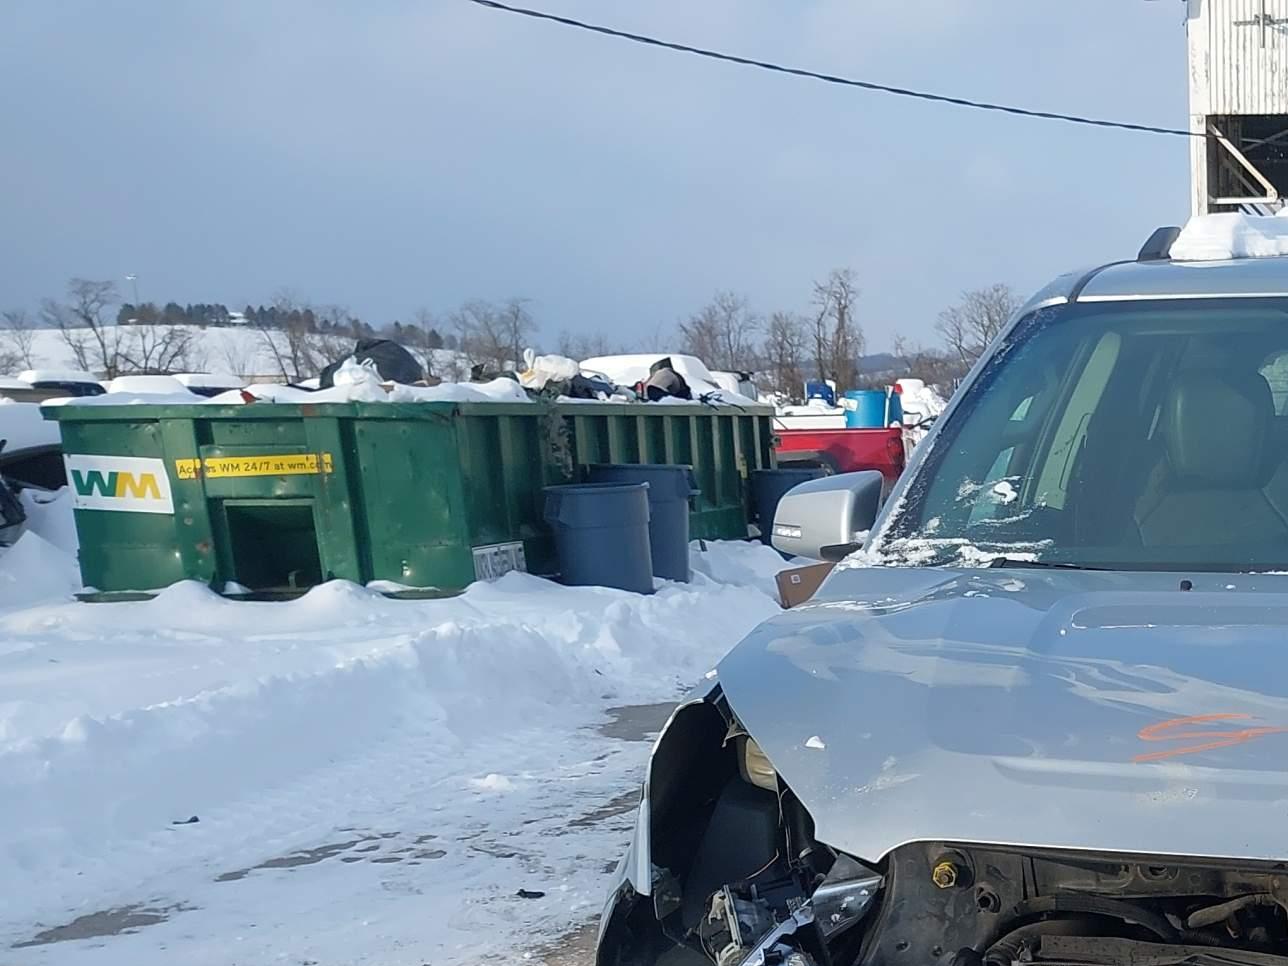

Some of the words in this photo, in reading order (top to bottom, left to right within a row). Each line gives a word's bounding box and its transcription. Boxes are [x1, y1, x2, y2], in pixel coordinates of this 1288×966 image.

[178, 465, 217, 475] Acss
[219, 463, 241, 473] WM
[244, 461, 271, 473] 24/7
[274, 461, 285, 471] at
[70, 468, 161, 500] WM
